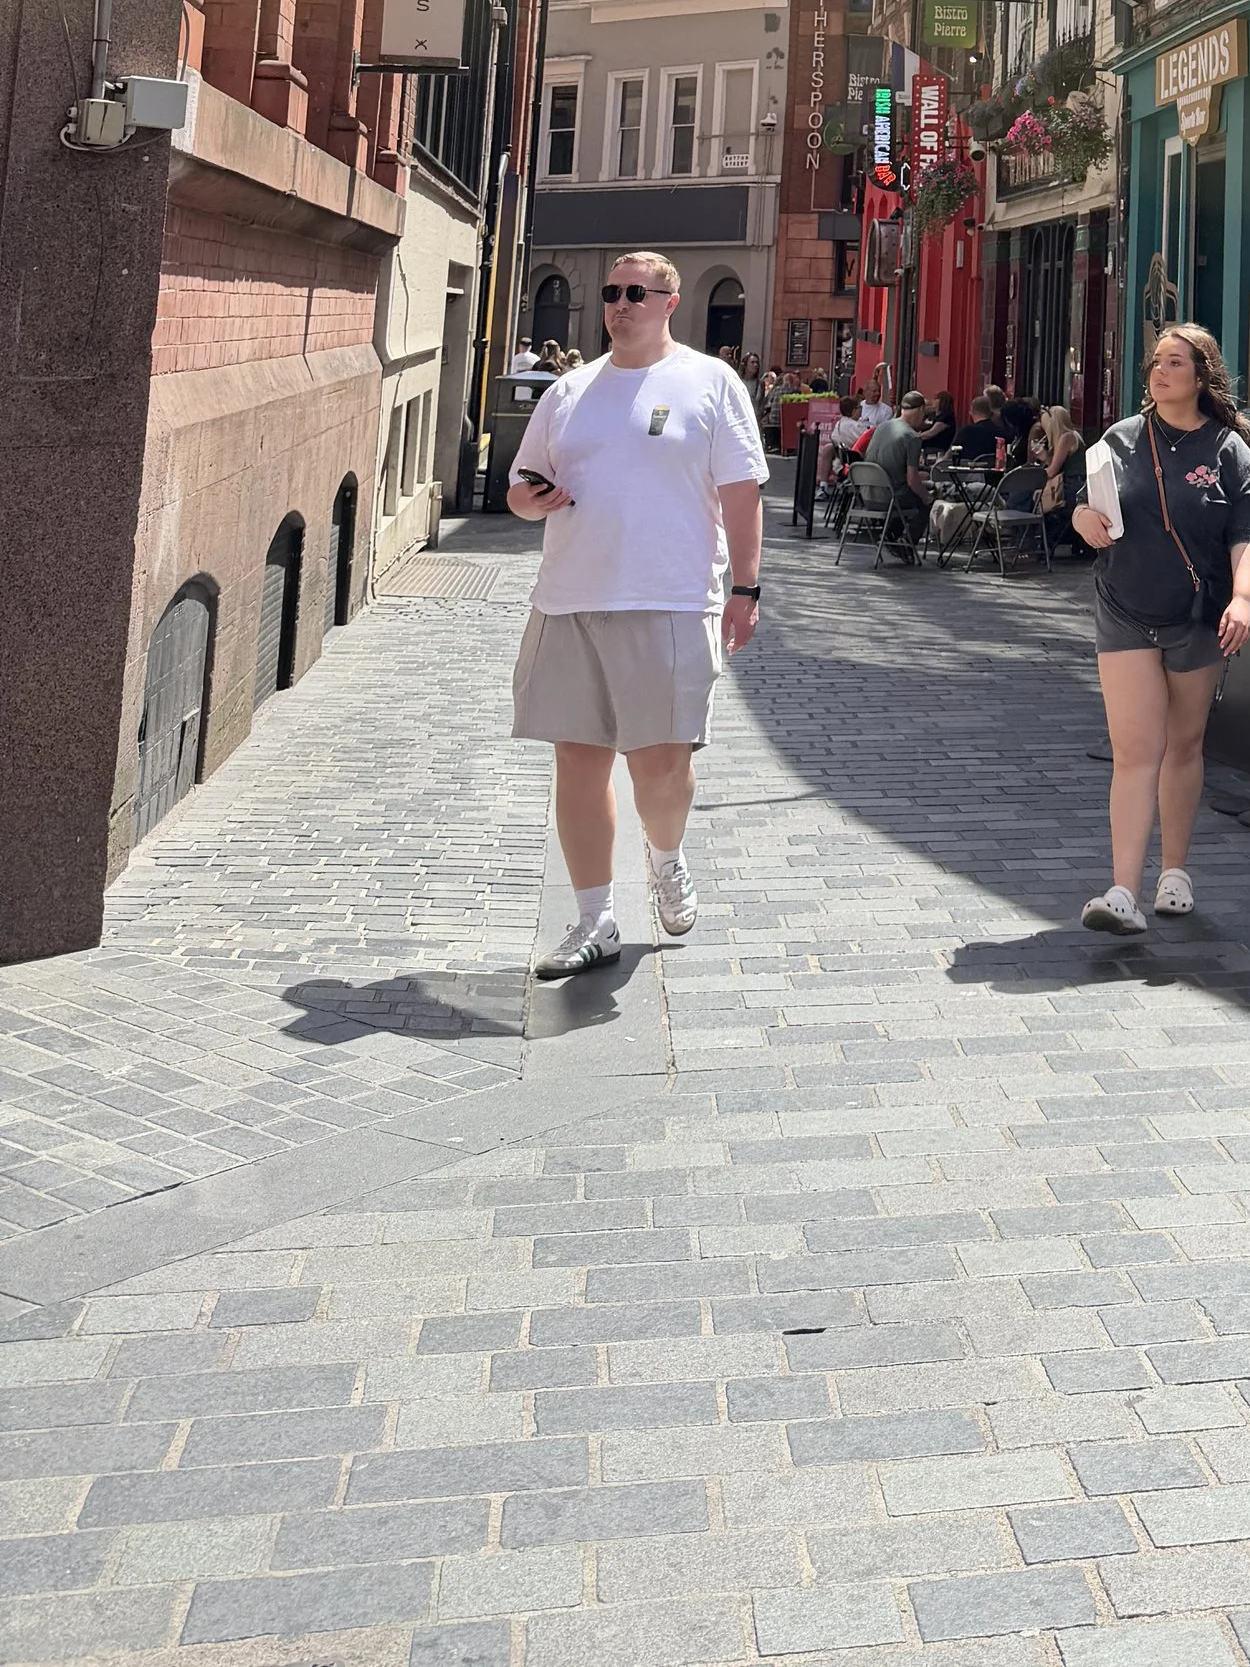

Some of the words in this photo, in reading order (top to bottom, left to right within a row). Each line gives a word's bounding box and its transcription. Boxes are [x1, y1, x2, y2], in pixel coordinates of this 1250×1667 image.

[934, 5, 968, 20] Bistro
[933, 22, 967, 37] Pierre
[1160, 29, 1230, 100] LEGENDS
[847, 87, 864, 101] Pie
[874, 88, 892, 114] IRISH
[920, 85, 940, 128] WALL
[874, 115, 891, 164] AMERICAN
[919, 131, 938, 152] OF
[874, 165, 897, 186] BAR
